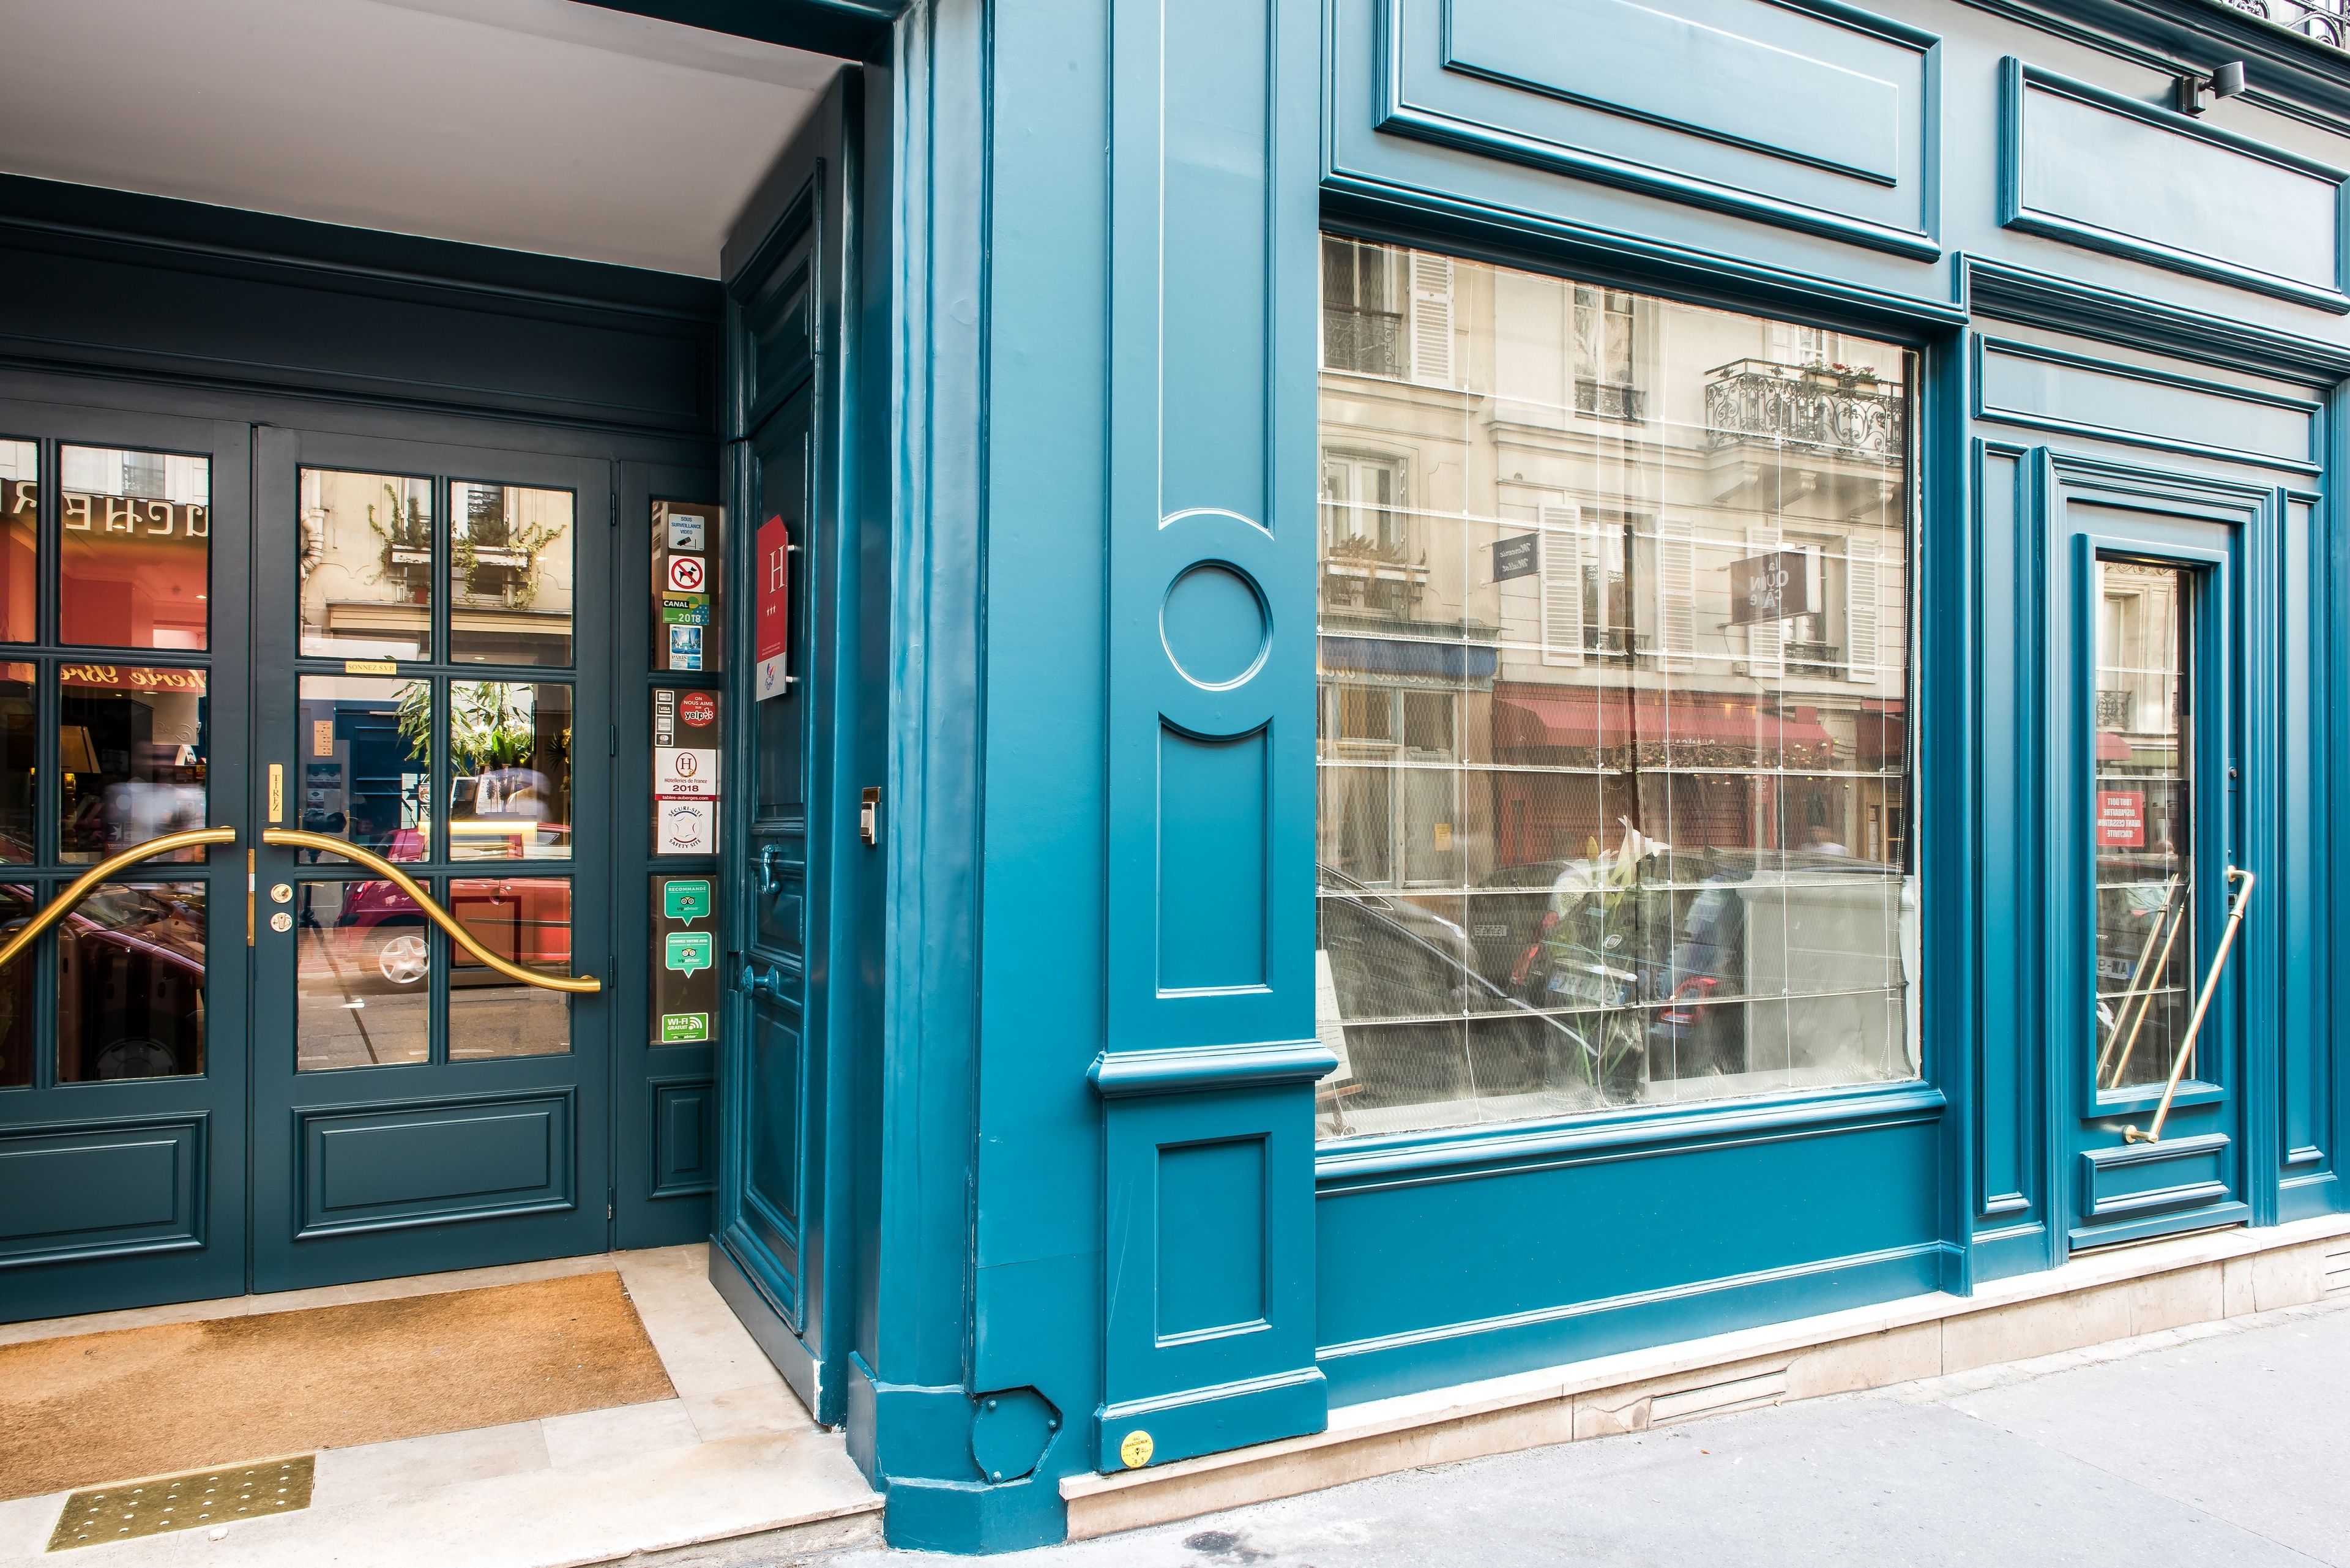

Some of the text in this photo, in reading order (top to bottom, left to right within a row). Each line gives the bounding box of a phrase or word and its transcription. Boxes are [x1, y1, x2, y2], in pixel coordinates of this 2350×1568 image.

[769, 544, 786, 594] H
[678, 613, 701, 623] 2018
[684, 710, 704, 722] yelp
[680, 758, 692, 769] H
[272, 774, 281, 812] TIREZ
[668, 805, 703, 818] SÉCURI-SITE
[668, 838, 702, 849] SAFETY SITE
